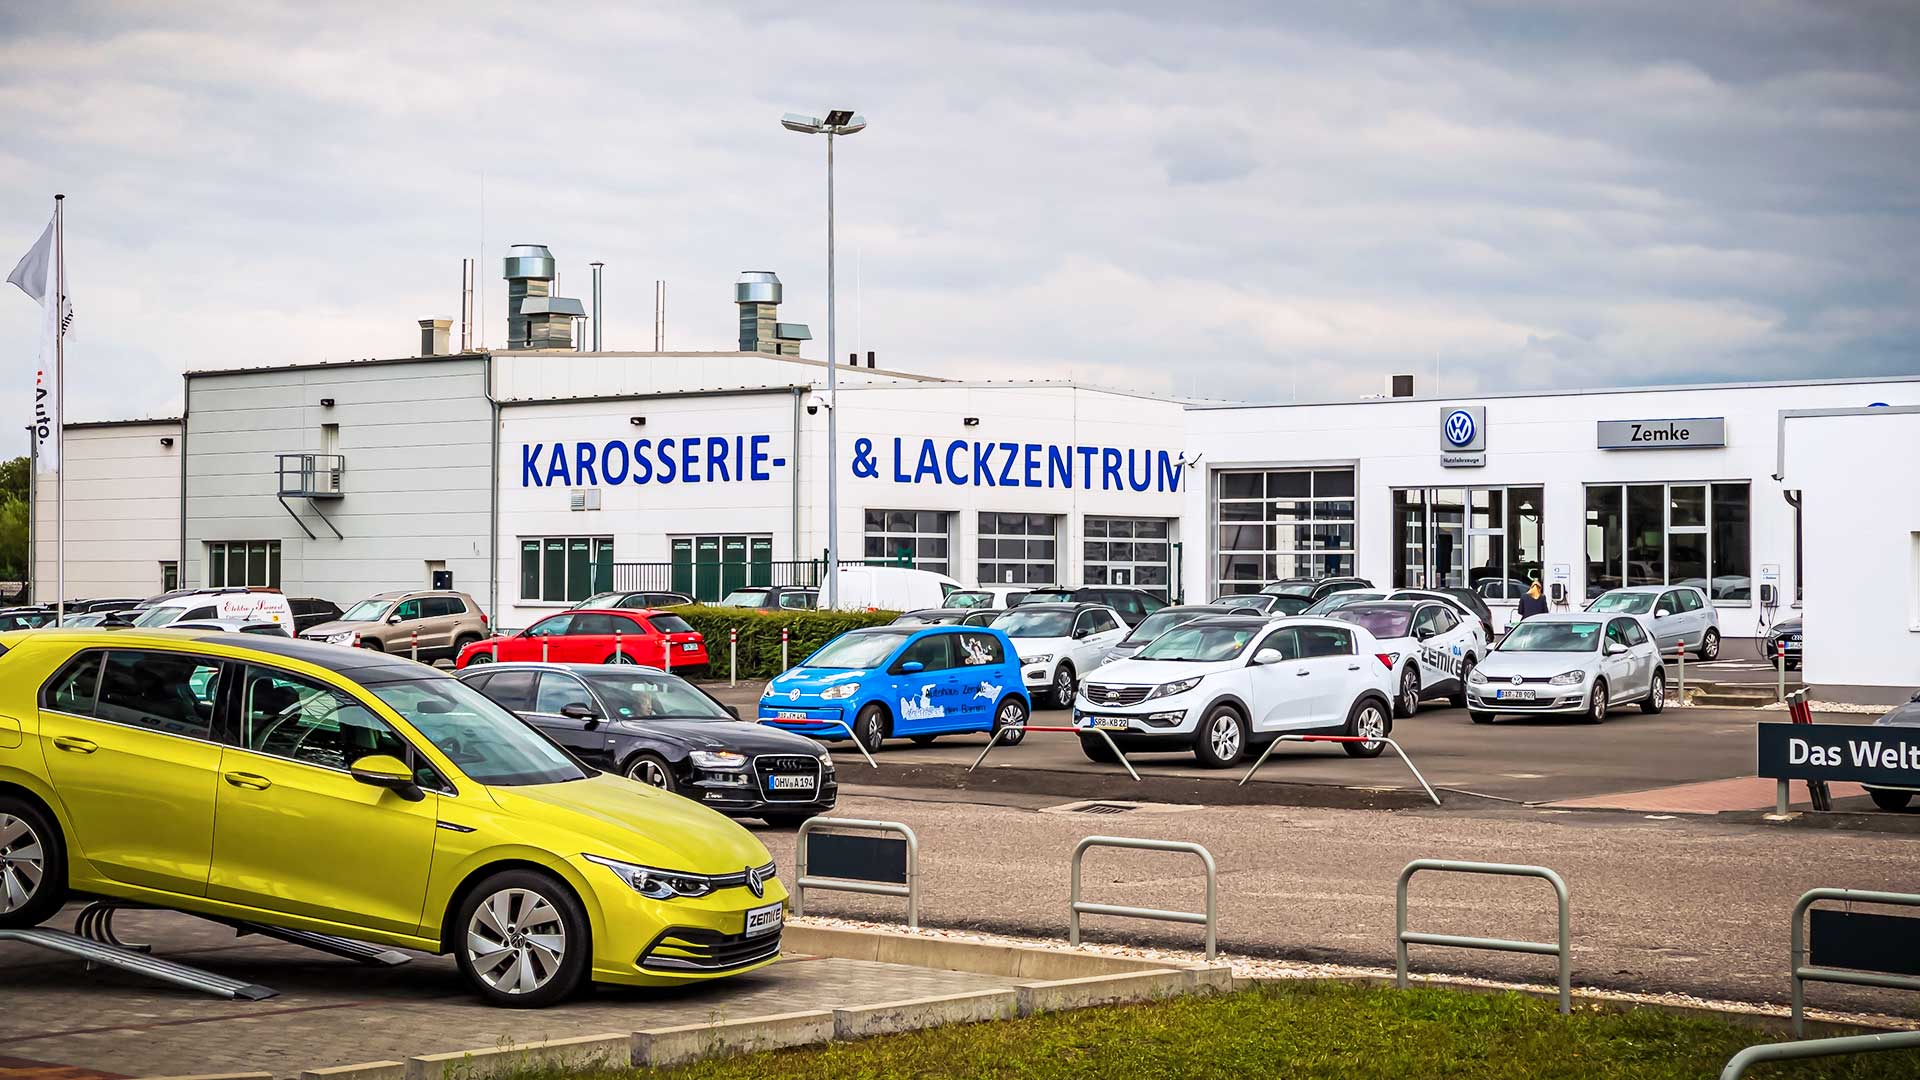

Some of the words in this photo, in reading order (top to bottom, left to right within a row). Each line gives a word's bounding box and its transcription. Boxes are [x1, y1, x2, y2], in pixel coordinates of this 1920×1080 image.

[1631, 423, 1690, 441] Zemke
[522, 435, 786, 487] KAROSSERIE-
[852, 437, 879, 478] &
[894, 437, 1185, 492] LACKZENTRUM
[1421, 647, 1462, 678] ZEMKE
[1789, 738, 1841, 766] Das
[1848, 740, 1920, 769] Welt
[775, 777, 790, 788] OHV
[750, 908, 781, 928] ZEMKE
